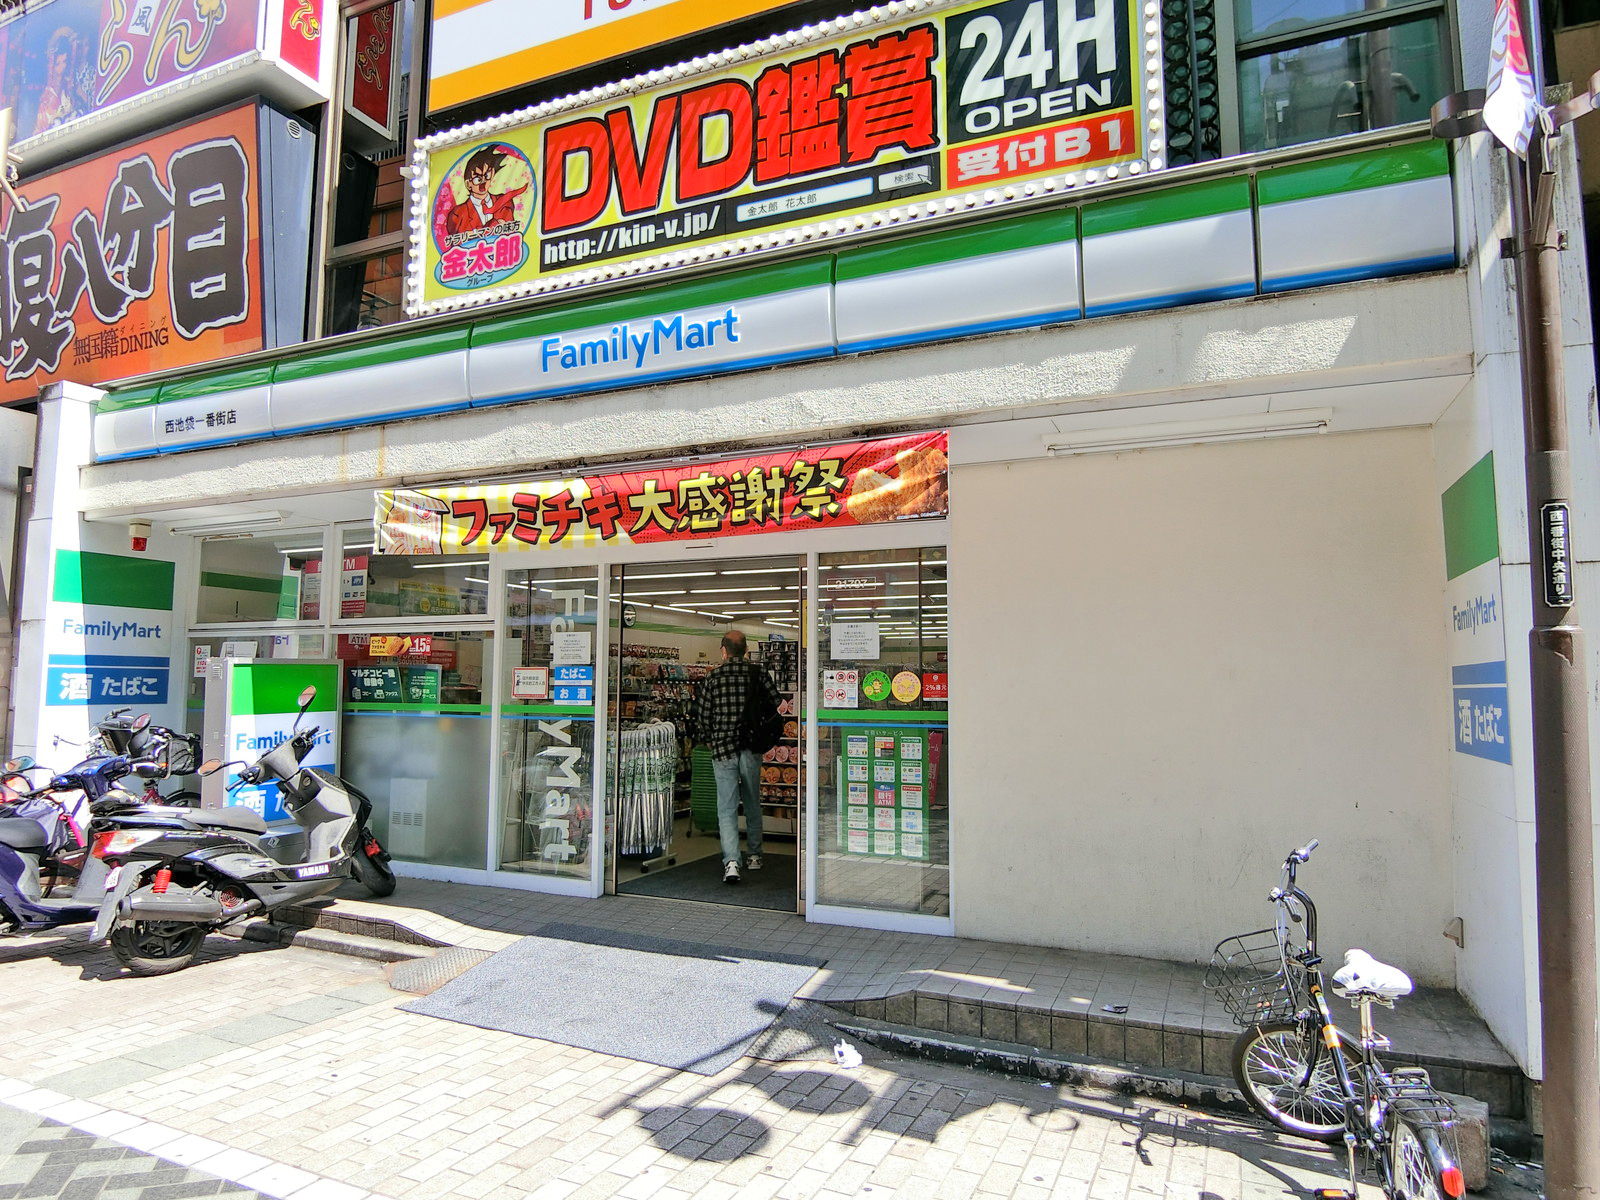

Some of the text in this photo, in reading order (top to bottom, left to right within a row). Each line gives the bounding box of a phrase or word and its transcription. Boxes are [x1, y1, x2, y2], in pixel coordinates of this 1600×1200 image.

[959, 0, 1117, 107] 24H
[965, 78, 1112, 134] OPEN
[541, 24, 940, 234] DVD鑑賞
[893, 172, 915, 185] 検索
[747, 193, 818, 218] 金太郎 花太郎
[444, 220, 521, 246] サラリーマンの味方
[544, 205, 721, 266] http://kin-v.jp/
[442, 233, 523, 281] 金太郎
[466, 274, 494, 287] グループ
[120, 315, 167, 335] ダイニング
[541, 306, 740, 373] FamilyMart
[165, 409, 237, 434] 西池袋一番街店
[1549, 510, 1567, 595] 西一番街中央通り
[1453, 593, 1497, 635] FamilyMart
[63, 618, 162, 640] FamilyMart
[59, 672, 158, 699] 酒 たばこ
[560, 668, 587, 679] たばこ
[1458, 698, 1505, 746] 酒 たばこ
[296, 864, 330, 878] YAMAHA
